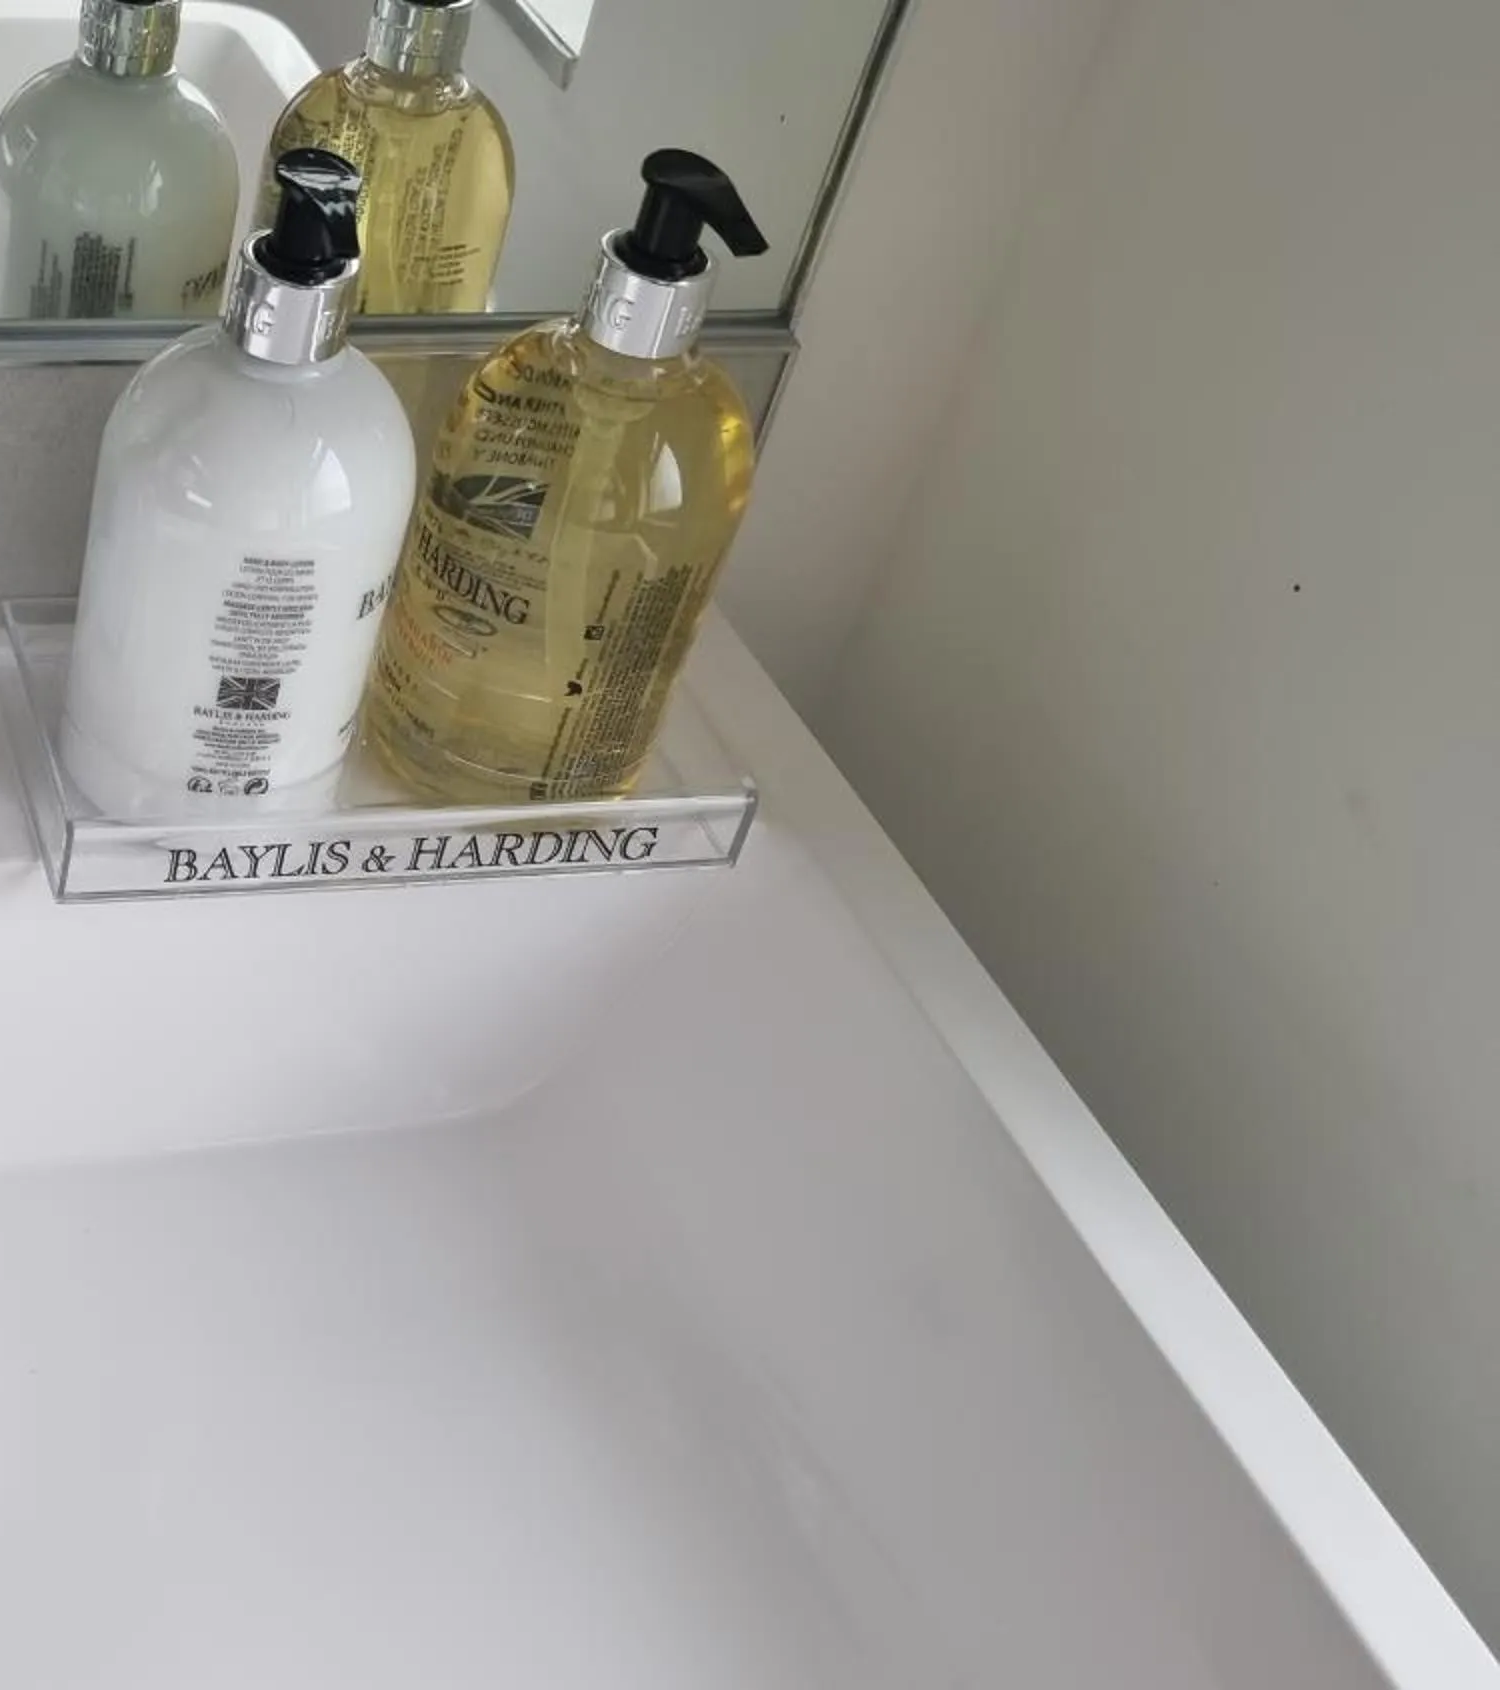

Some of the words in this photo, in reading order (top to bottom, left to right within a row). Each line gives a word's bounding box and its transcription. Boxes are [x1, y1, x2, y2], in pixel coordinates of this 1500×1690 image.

[418, 524, 531, 625] HARDING
[164, 840, 351, 883] BAYLIS
[361, 845, 396, 873] &
[404, 827, 659, 871] HARDING
